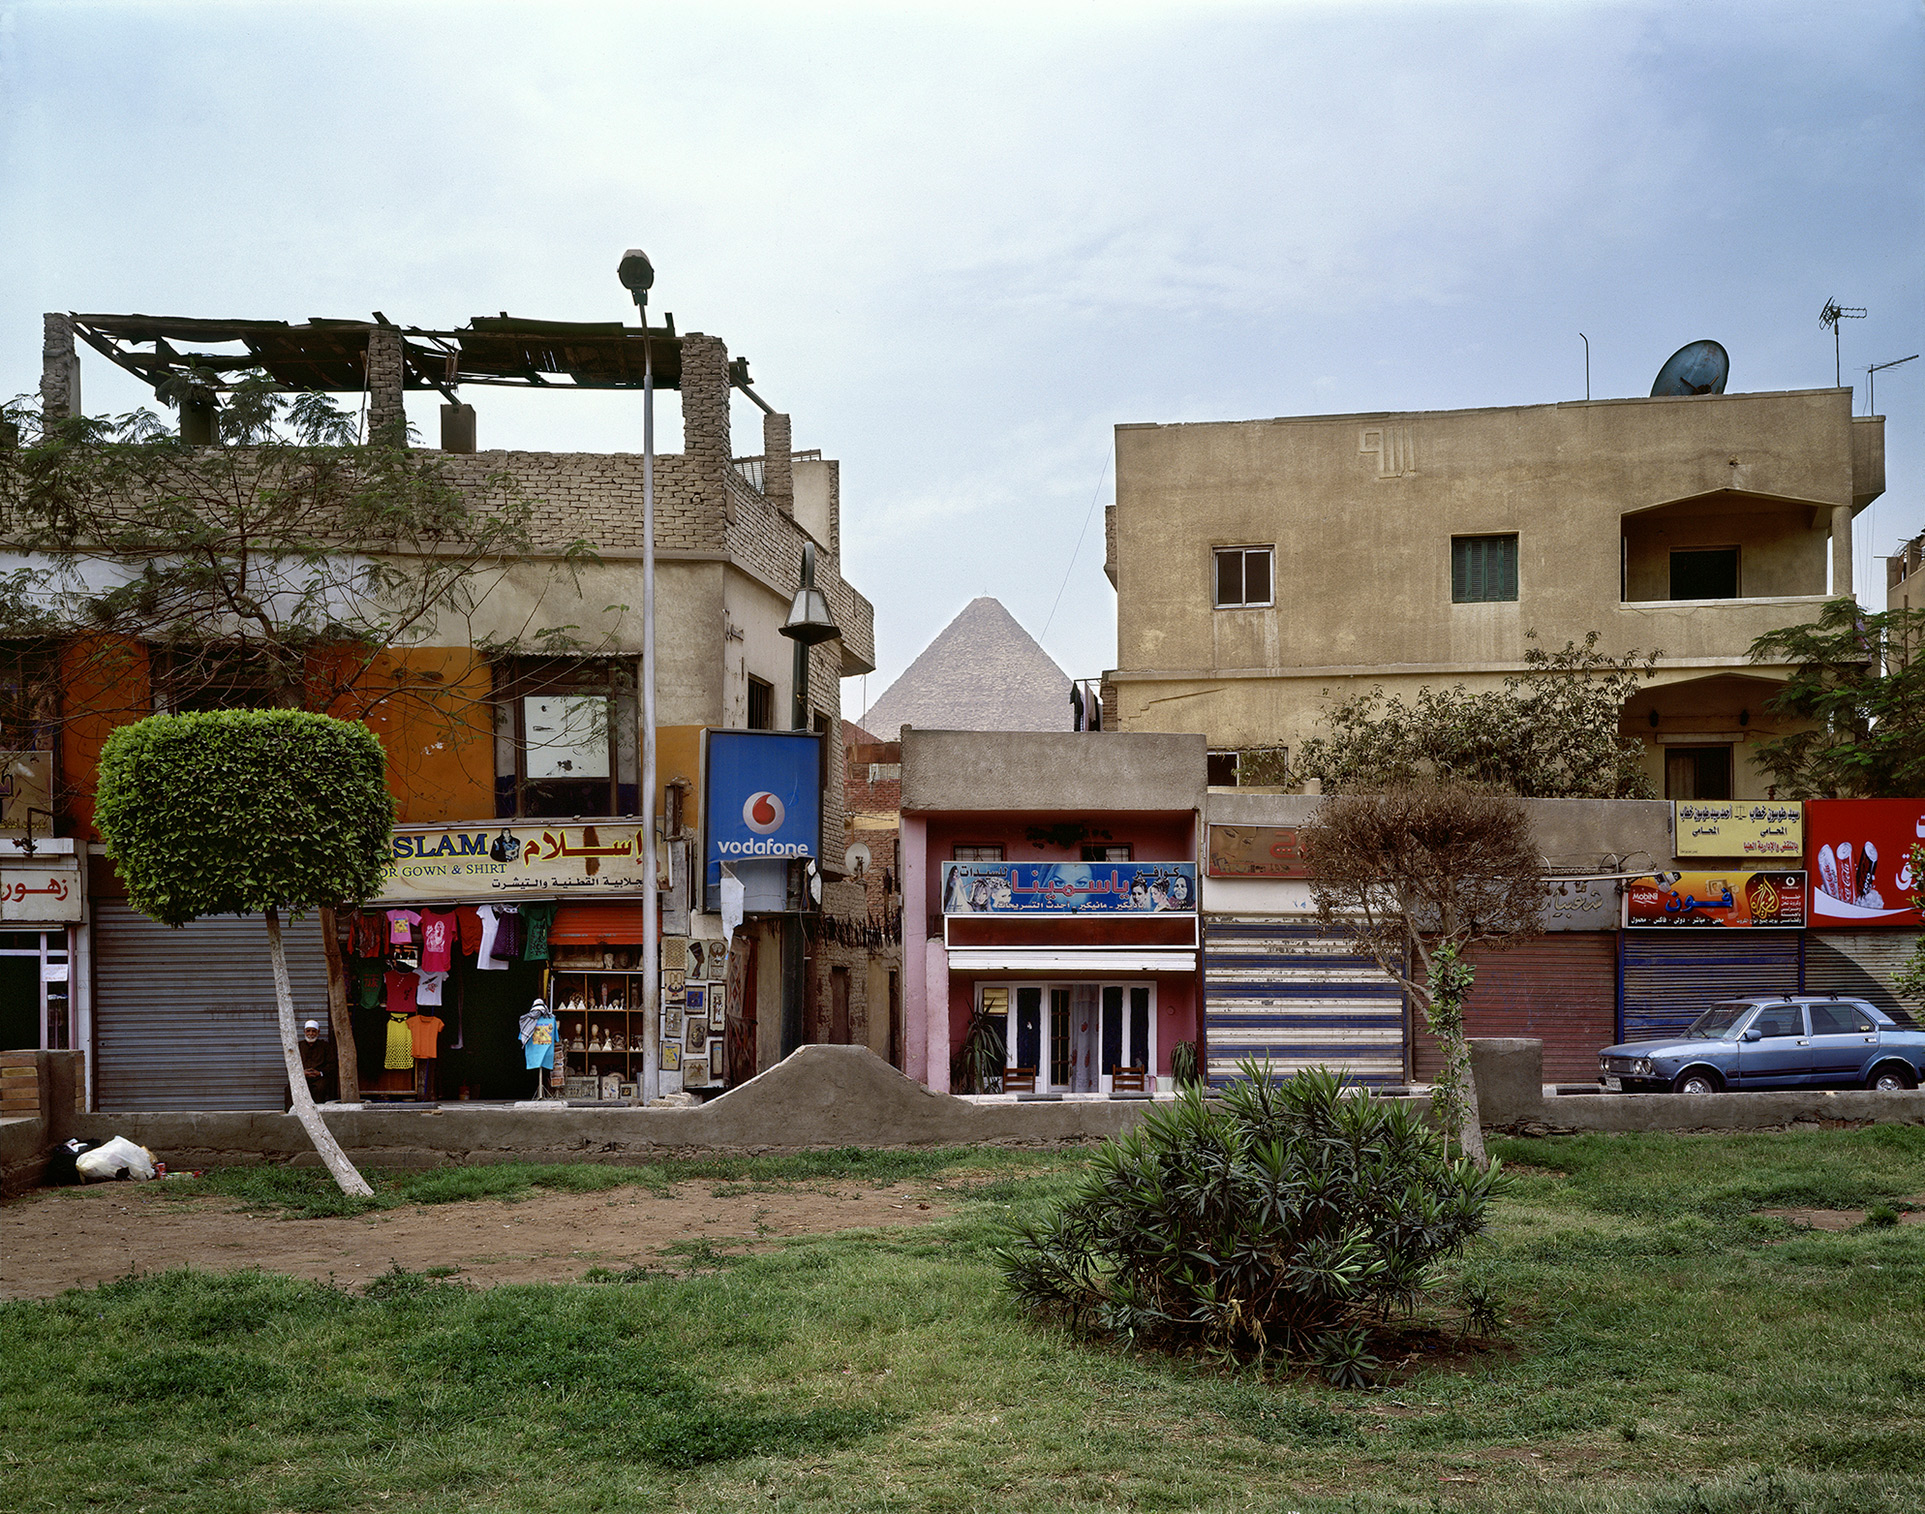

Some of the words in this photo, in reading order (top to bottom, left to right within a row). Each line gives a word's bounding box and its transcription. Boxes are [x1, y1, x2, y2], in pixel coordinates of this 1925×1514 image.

[388, 833, 489, 859] SLAM
[717, 838, 809, 855] vodafone
[380, 867, 398, 878] OR
[402, 865, 447, 877] GOWN
[451, 864, 462, 875] &
[466, 863, 507, 875] SHIRT
[960, 865, 1008, 880] للسيدات
[1132, 866, 1180, 880] كوافير
[1, 878, 69, 903] زهور
[551, 876, 599, 890] القطنية
[602, 876, 643, 890] جلابية
[1012, 869, 1129, 900] ياسمينا
[997, 901, 1044, 911] التسريحات
[1665, 888, 1733, 912] فون
